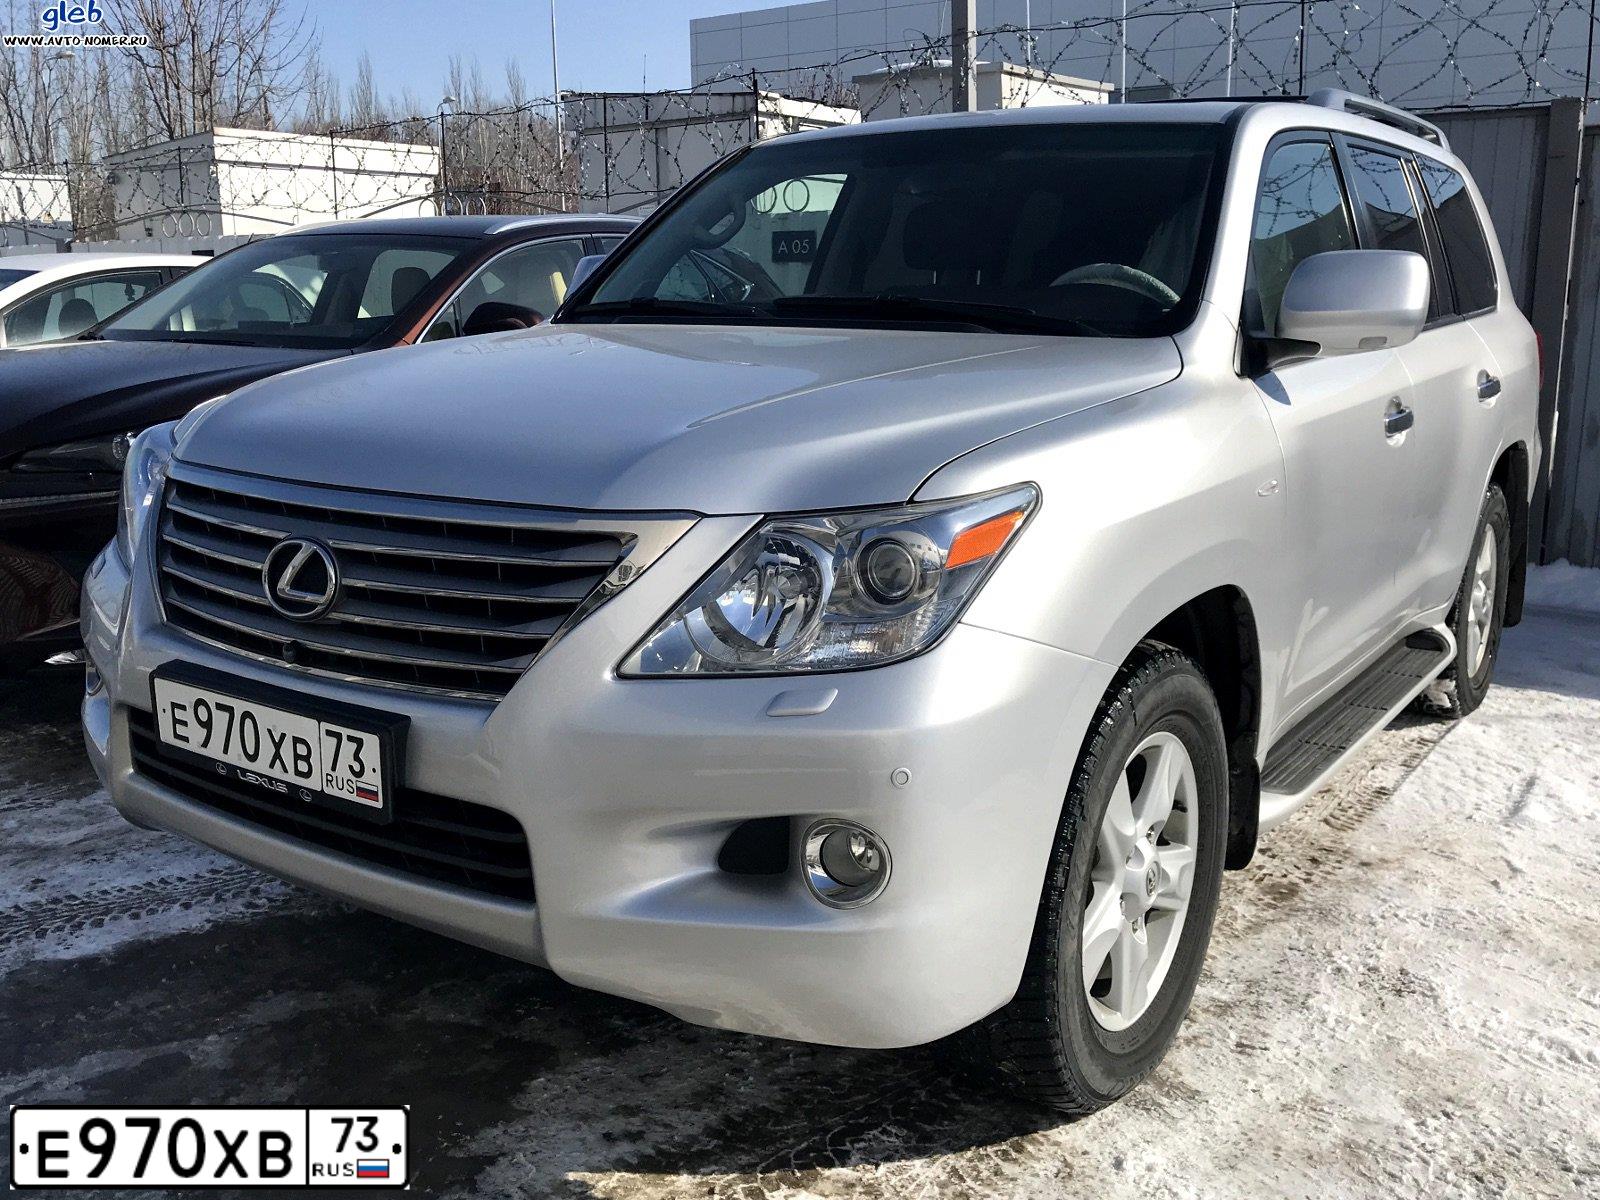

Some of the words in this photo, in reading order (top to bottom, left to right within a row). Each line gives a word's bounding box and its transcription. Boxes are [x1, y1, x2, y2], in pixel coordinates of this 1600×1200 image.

[778, 240, 788, 254] A
[792, 239, 810, 254] 05
[170, 697, 313, 779] E970XB
[325, 729, 366, 779] 73
[236, 769, 288, 794] LEXUS
[325, 772, 355, 795] RUS
